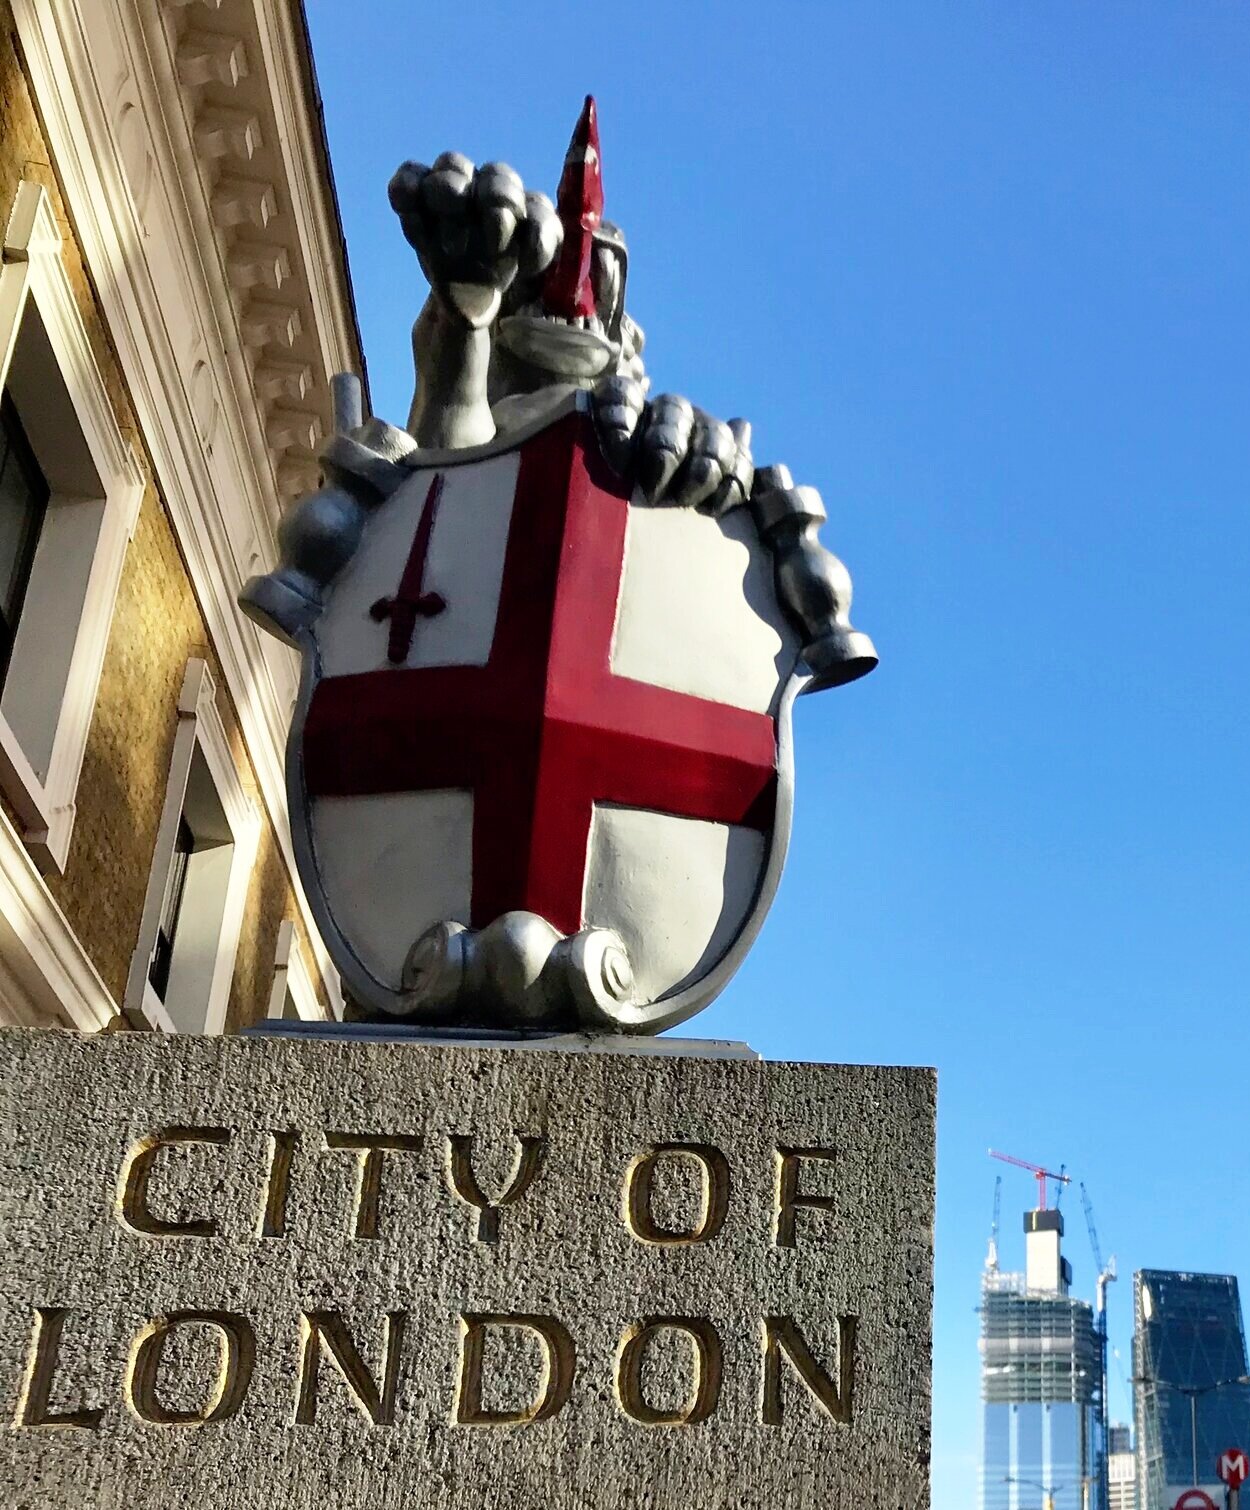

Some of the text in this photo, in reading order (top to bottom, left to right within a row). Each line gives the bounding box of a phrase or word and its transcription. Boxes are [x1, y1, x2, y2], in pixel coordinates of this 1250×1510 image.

[119, 1125, 836, 1247] CITY OF
[14, 1307, 859, 1428] LONDON
[1221, 1454, 1245, 1480] M
